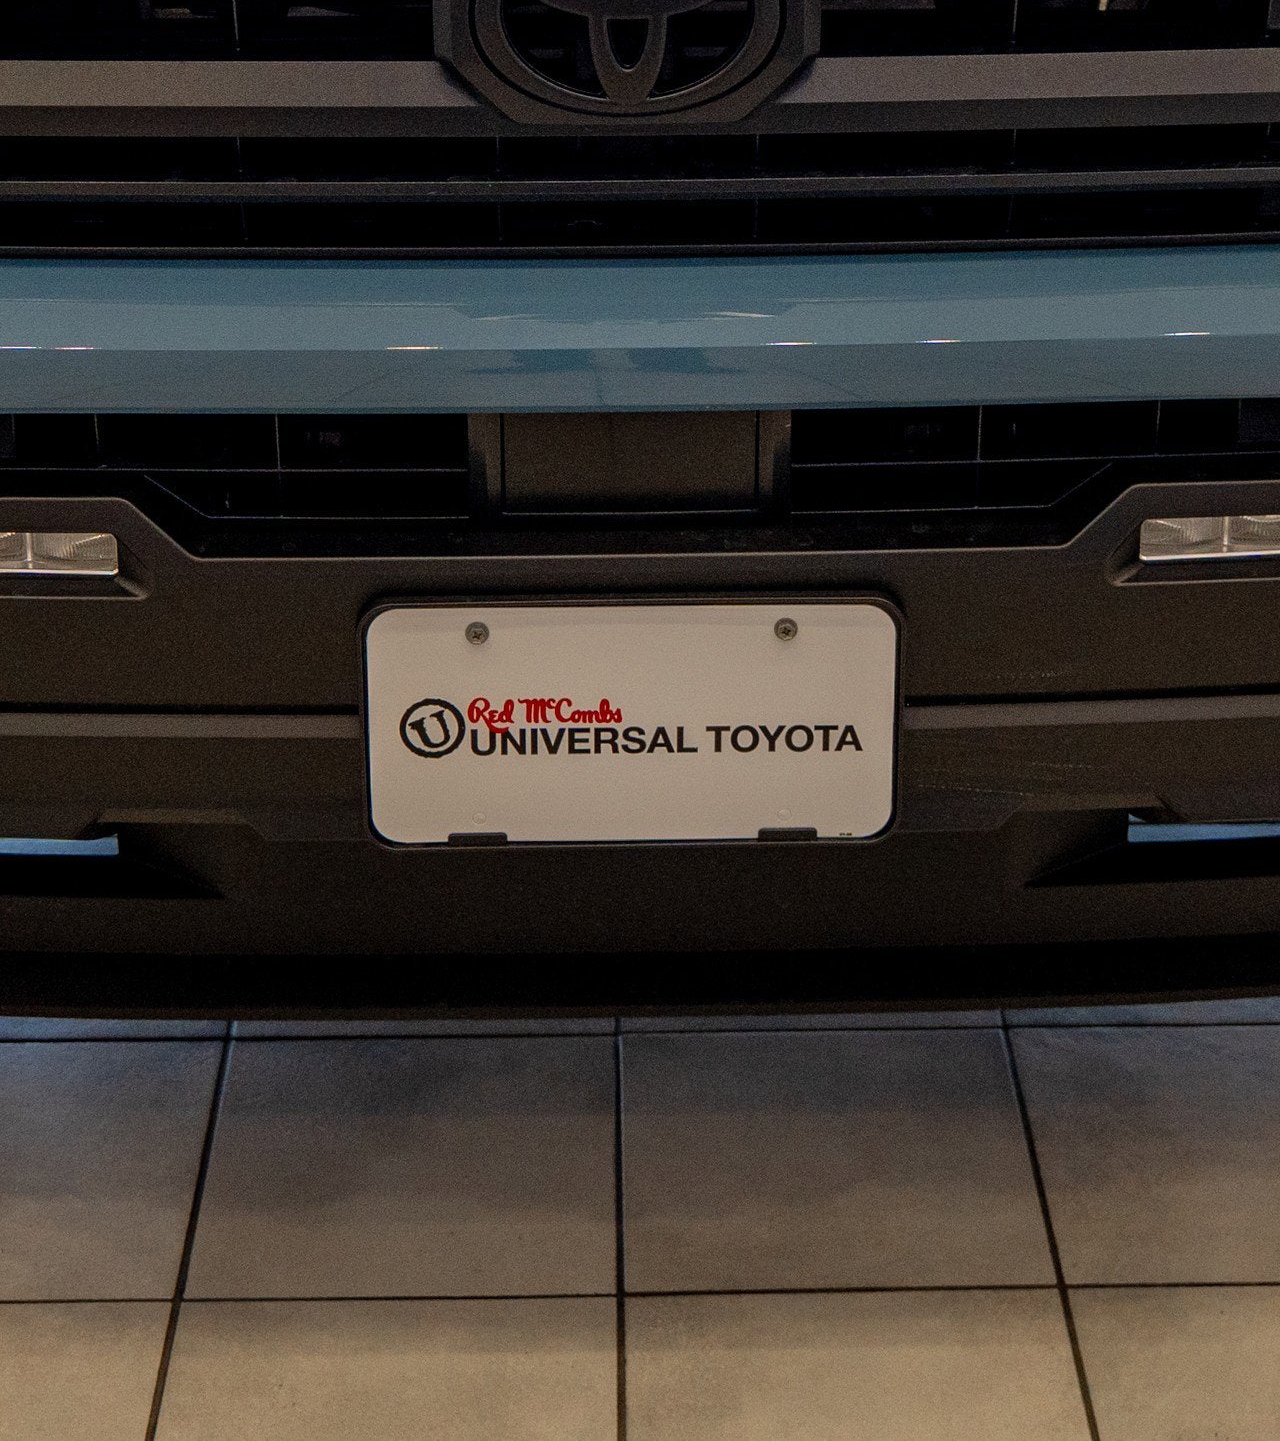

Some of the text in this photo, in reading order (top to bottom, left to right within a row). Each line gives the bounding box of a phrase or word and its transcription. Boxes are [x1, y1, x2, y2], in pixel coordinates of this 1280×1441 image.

[467, 697, 623, 734] Red McCombs
[469, 723, 864, 756] UNIVERSAL TOYOTA
